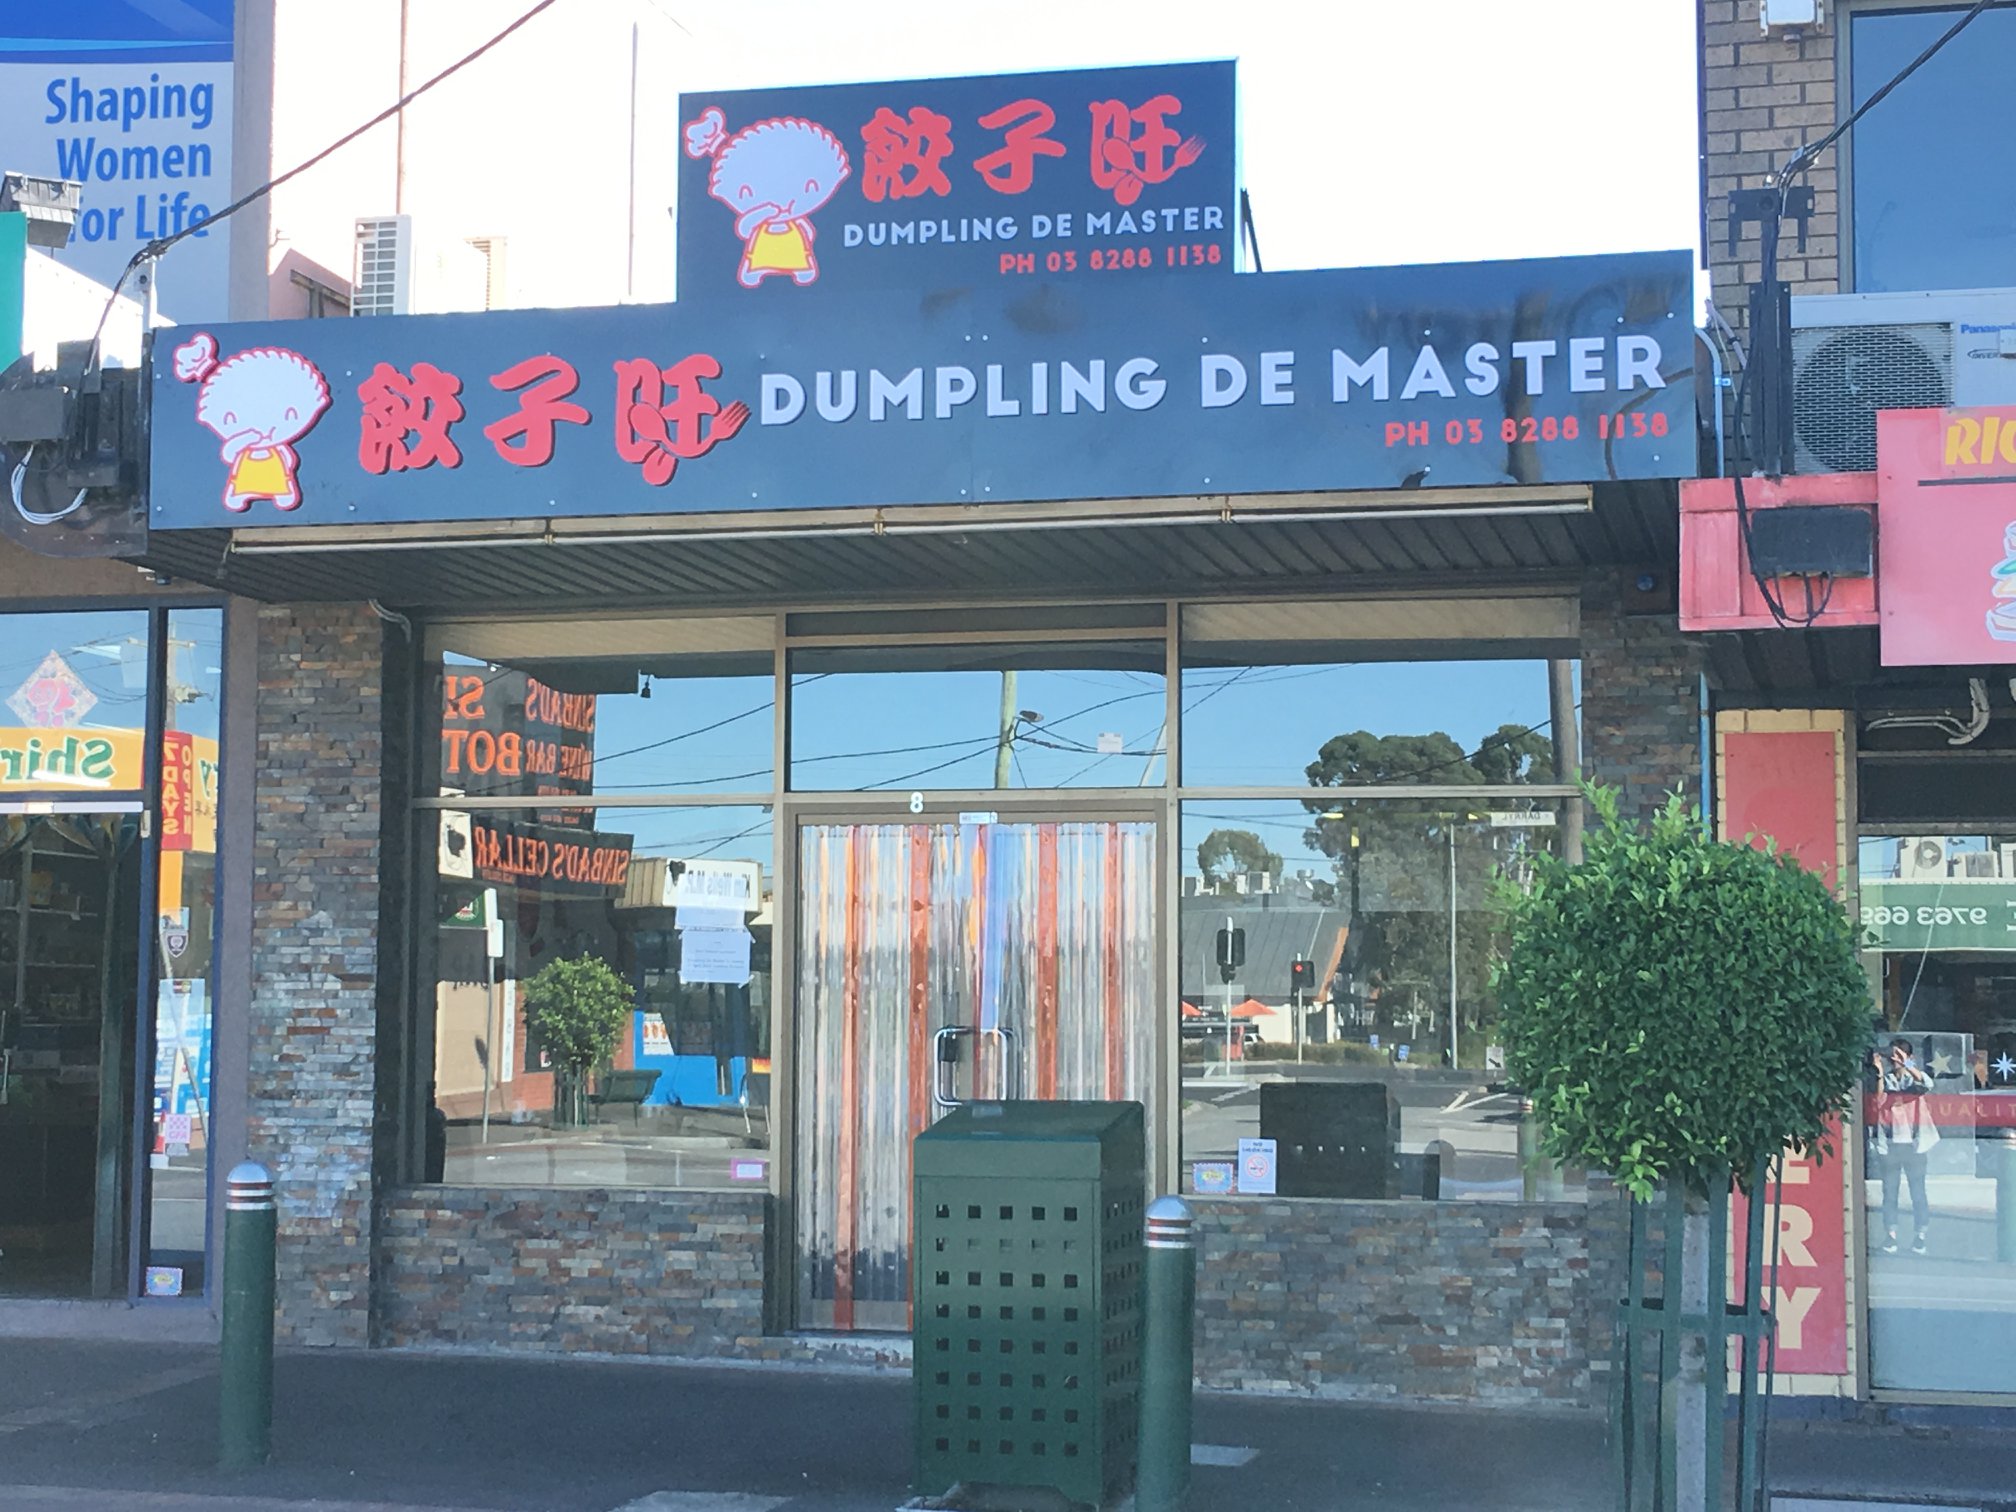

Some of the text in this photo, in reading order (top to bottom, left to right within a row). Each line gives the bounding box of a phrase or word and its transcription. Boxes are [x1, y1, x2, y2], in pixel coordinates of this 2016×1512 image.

[45, 73, 214, 132] Shaping
[56, 136, 212, 182] Women
[136, 191, 211, 240] Life
[843, 206, 1224, 247] DUMPLING DE MASTER
[999, 244, 1222, 274] PH 03 8288 1138
[761, 335, 1667, 426] DUMPLING DE MASTER
[1385, 412, 1670, 447] PH 03 8288 1138
[909, 791, 924, 813] 8
